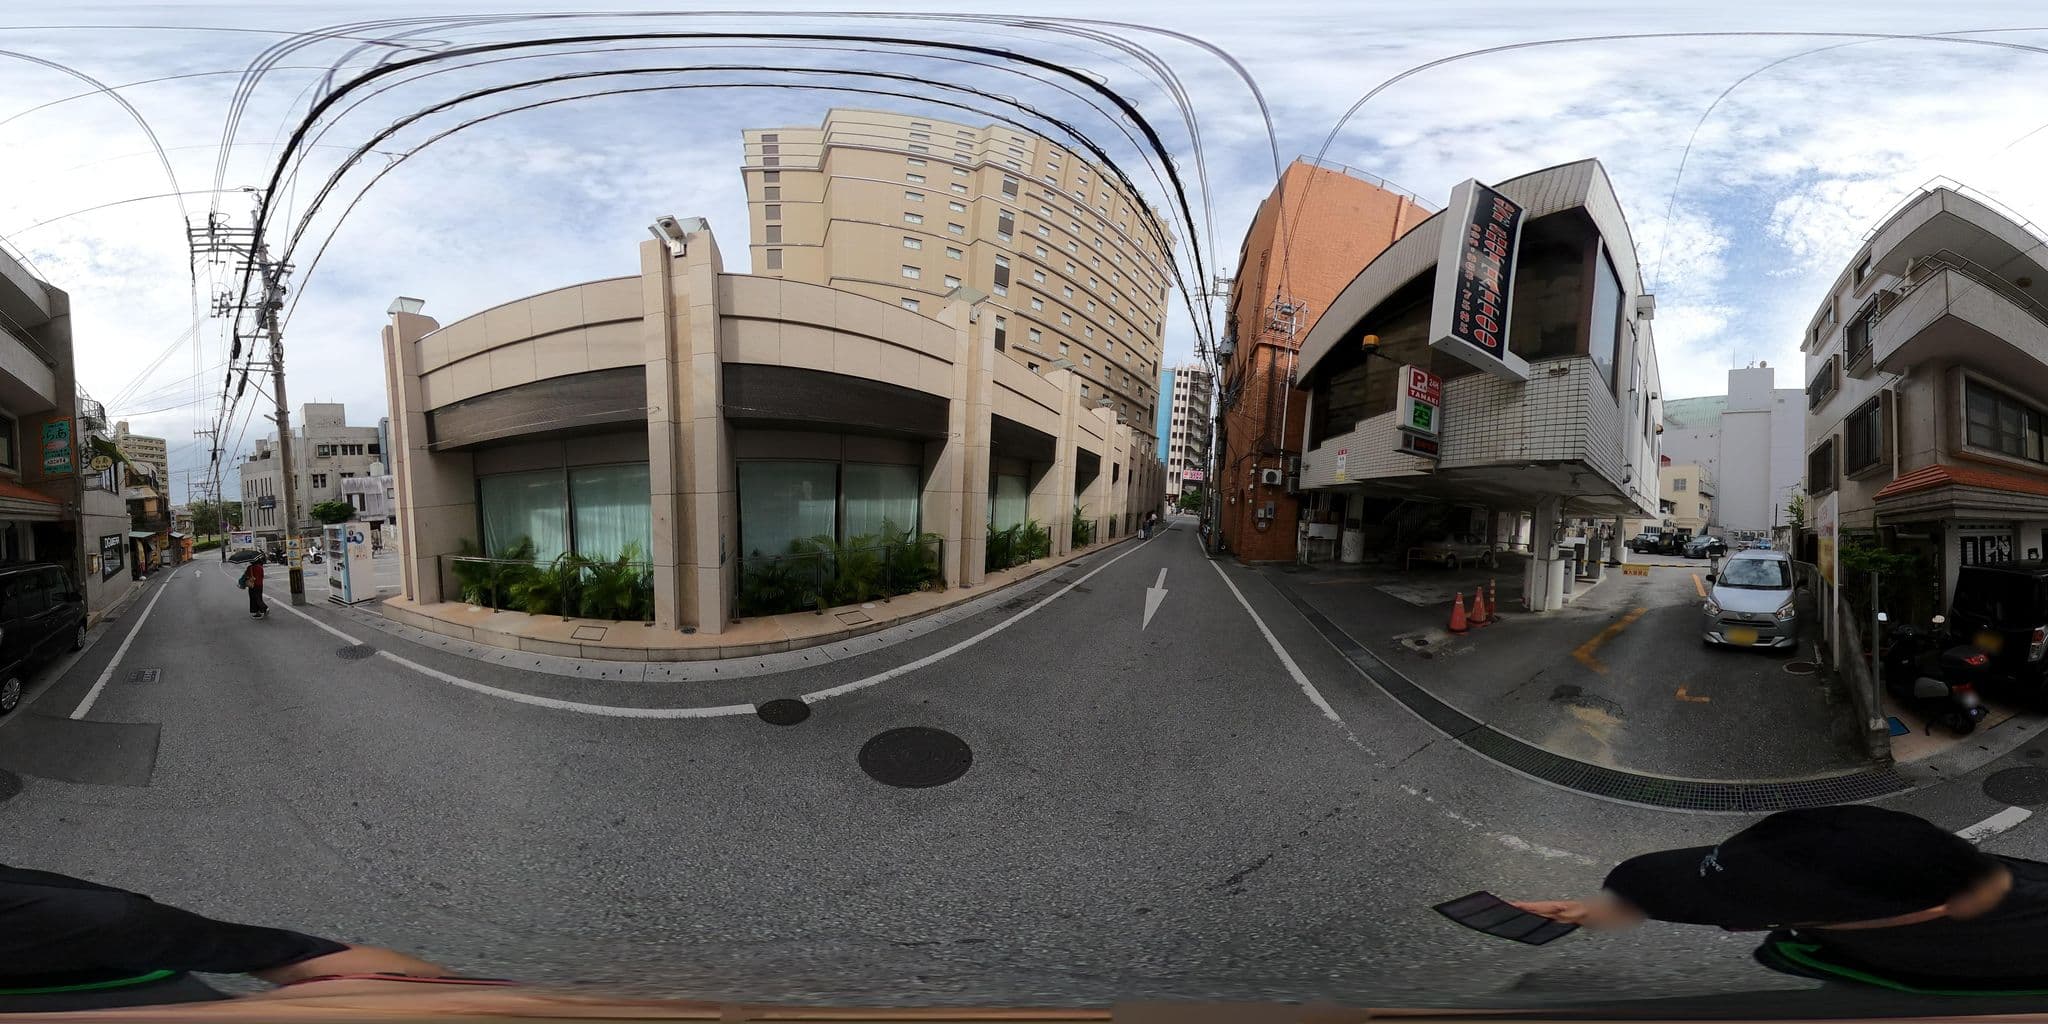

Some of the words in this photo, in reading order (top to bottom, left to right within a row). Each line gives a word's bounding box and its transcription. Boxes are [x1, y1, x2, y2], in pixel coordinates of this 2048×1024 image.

[1483, 223, 1508, 265] SHOT
[1473, 261, 1504, 348] TATTOO
[1410, 390, 1439, 406] TAMAKI
